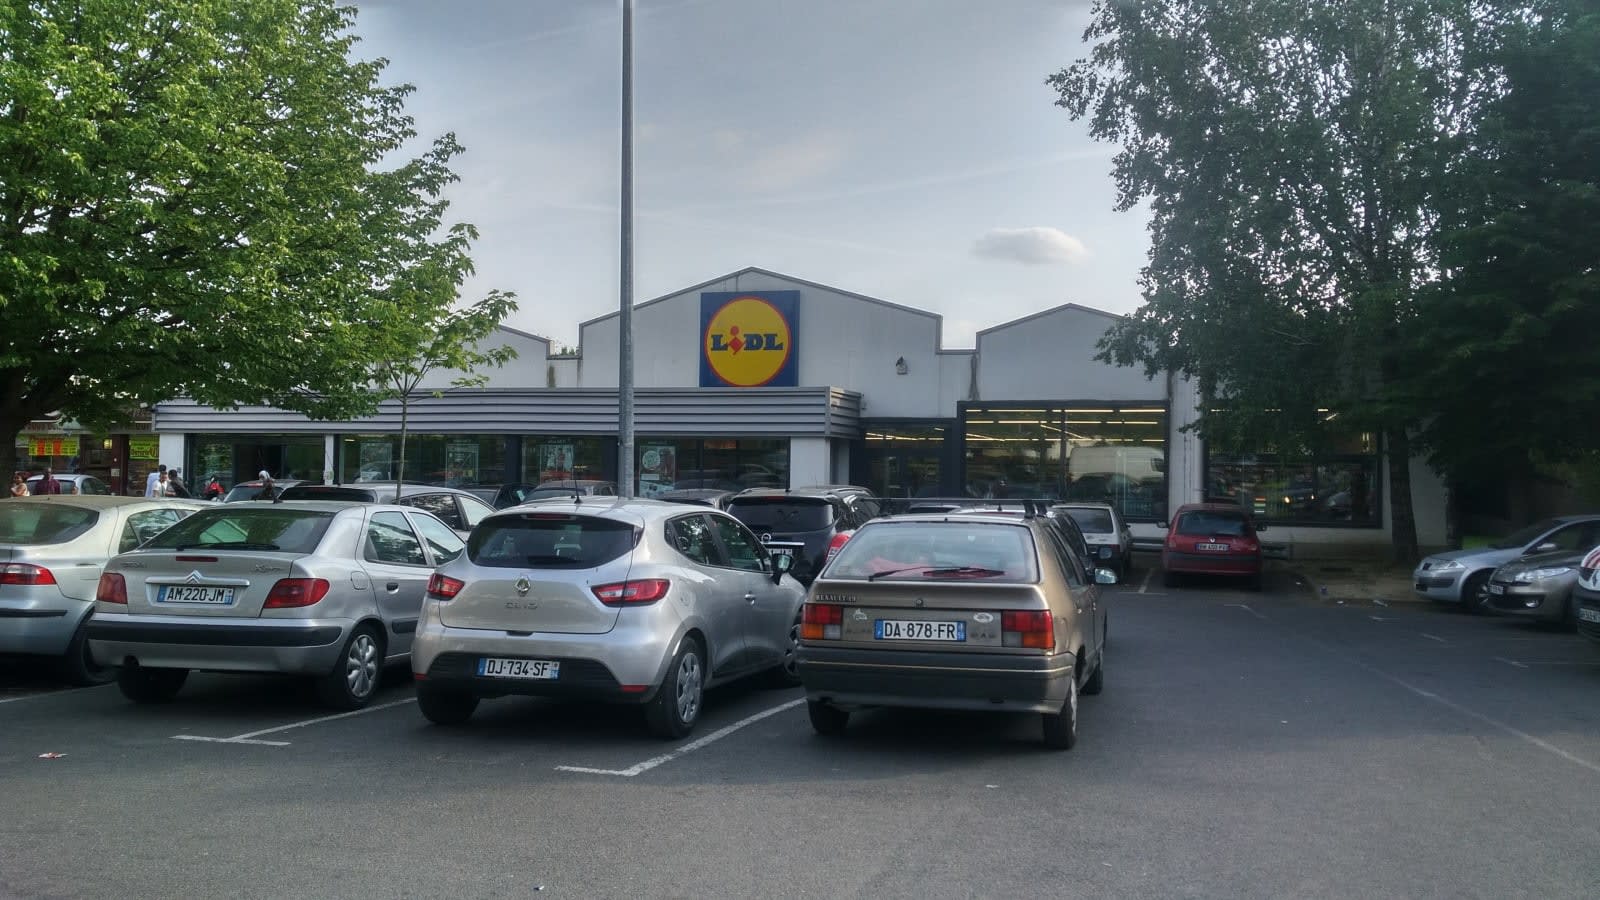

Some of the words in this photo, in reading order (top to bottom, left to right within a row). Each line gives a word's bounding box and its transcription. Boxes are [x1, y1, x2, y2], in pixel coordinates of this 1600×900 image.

[167, 586, 225, 602] AM-220-JM
[884, 622, 956, 639] DA-878-FR
[487, 660, 550, 677] DJ-734-SF
